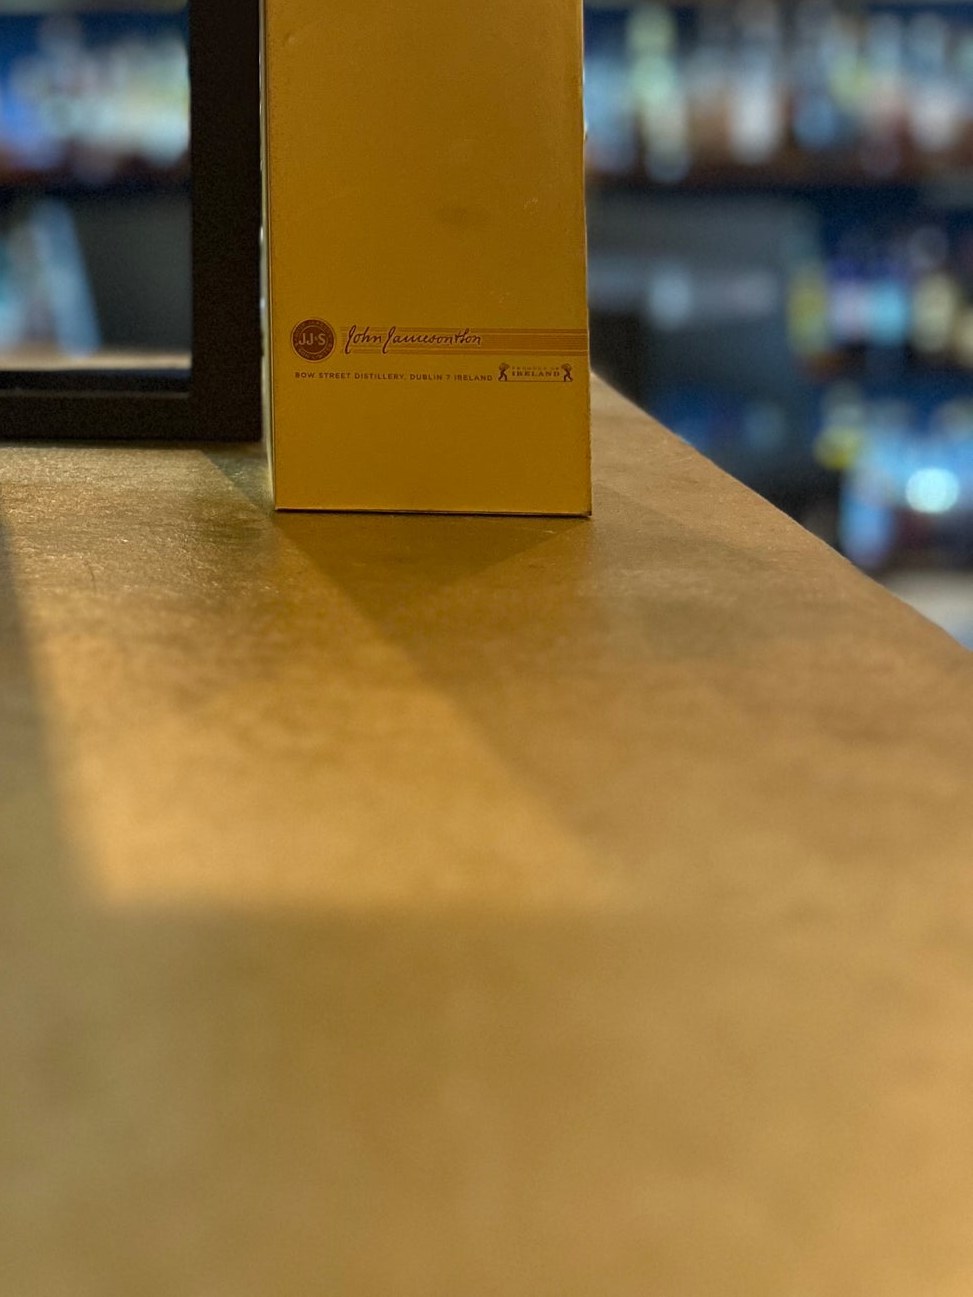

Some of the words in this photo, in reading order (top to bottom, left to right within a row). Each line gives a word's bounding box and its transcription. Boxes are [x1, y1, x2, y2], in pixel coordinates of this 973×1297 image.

[345, 324, 381, 354] John
[382, 325, 453, 354] Jameson
[295, 371, 315, 379] BOW
[410, 373, 443, 381] DUBLIN
[454, 373, 493, 382] IRELAND
